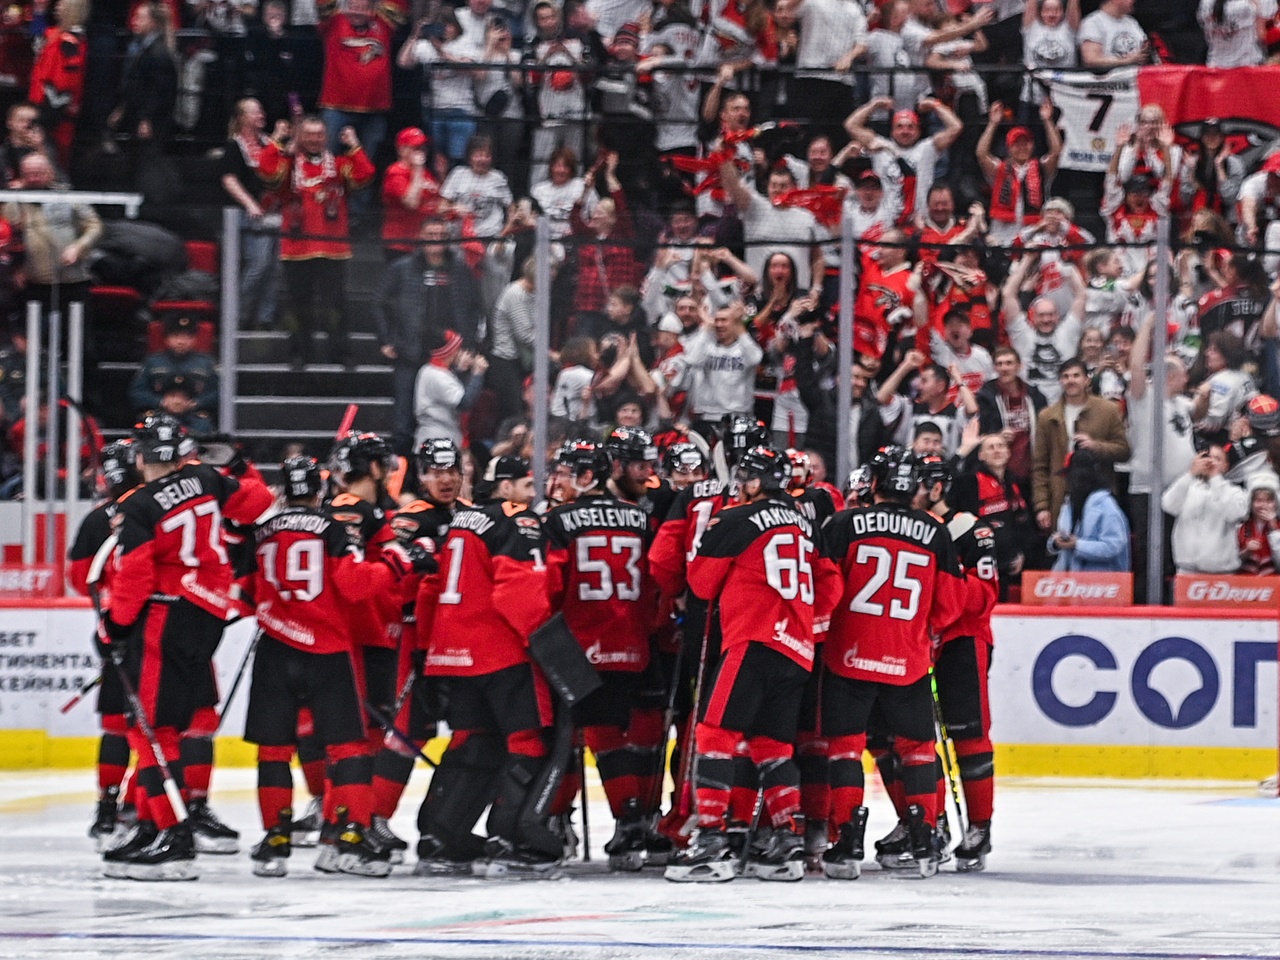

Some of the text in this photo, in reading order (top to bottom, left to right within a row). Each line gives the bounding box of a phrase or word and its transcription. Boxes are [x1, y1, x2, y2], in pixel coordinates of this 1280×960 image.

[1086, 94, 1113, 131] 7
[154, 476, 203, 520] BELOV
[560, 508, 647, 531] KISELEVICH
[852, 512, 938, 545] DEDUNOV
[161, 500, 229, 567] 77
[529, 547, 547, 572] 1
[257, 538, 325, 602] 19
[438, 537, 464, 604] 1
[576, 535, 642, 601] 53
[763, 533, 815, 605] 65
[849, 544, 931, 621] 25
